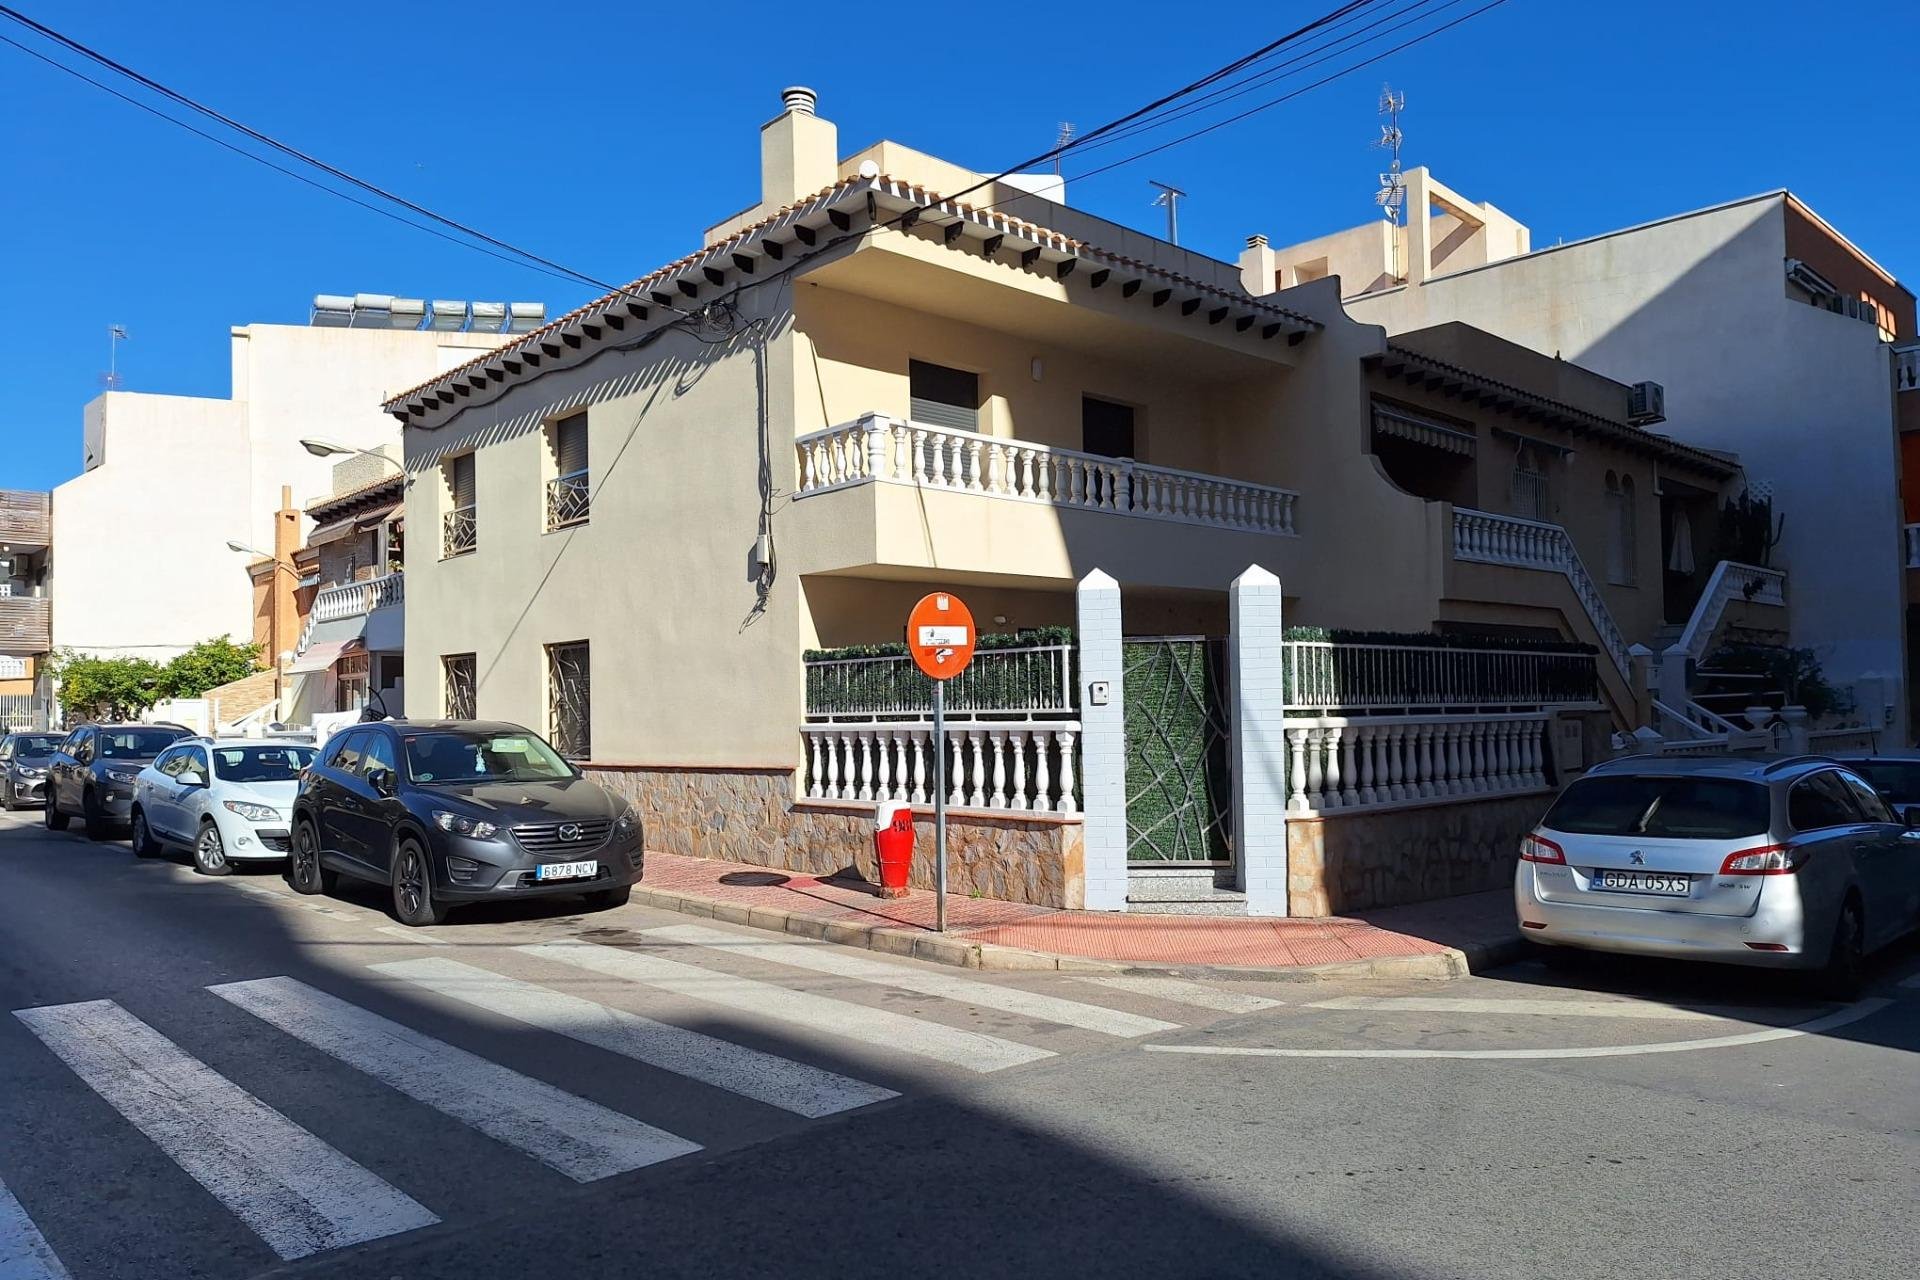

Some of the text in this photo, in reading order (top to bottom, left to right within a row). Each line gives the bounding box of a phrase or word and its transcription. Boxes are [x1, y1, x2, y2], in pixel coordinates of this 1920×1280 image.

[544, 863, 595, 876] 6878 NCV
[1605, 873, 1638, 888] GDA
[1645, 875, 1686, 892] 05X5
